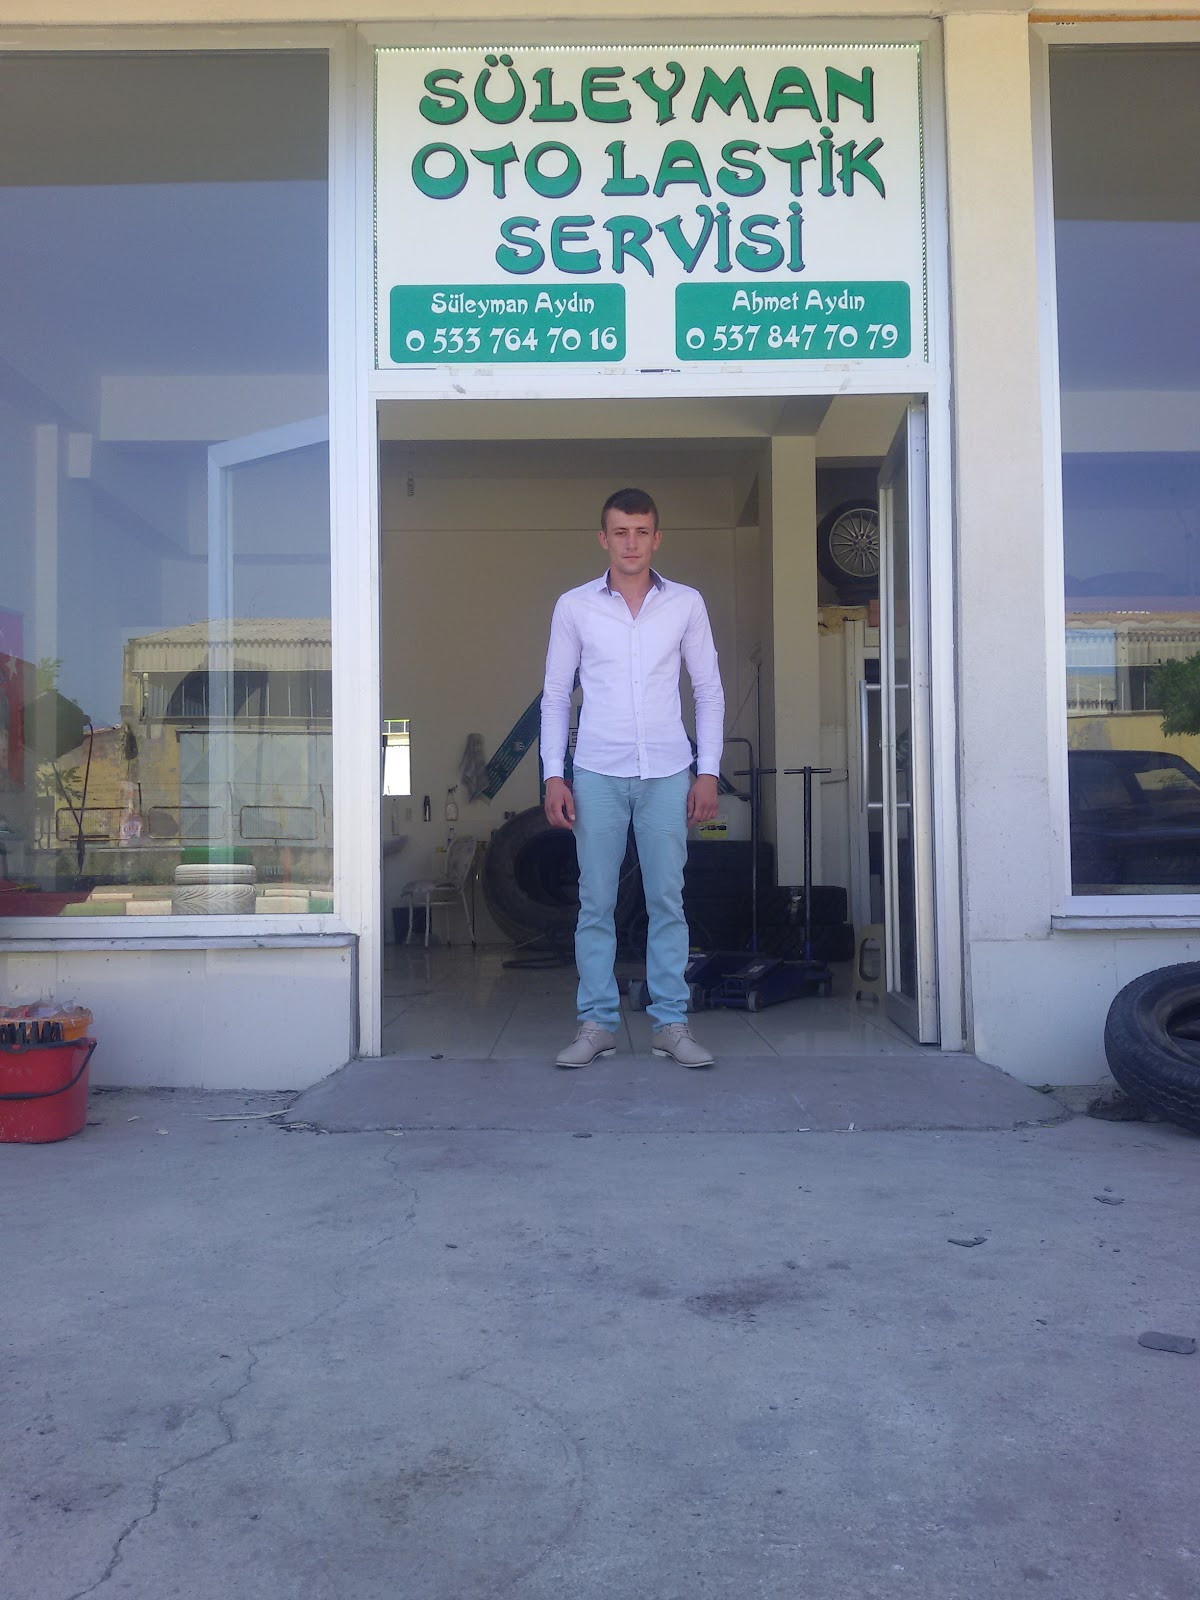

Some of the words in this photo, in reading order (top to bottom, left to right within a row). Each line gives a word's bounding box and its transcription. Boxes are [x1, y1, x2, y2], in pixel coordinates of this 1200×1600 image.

[419, 54, 875, 126] SÜLEYMAN
[411, 140, 582, 200] OTO
[600, 126, 886, 200] LASTİK
[495, 201, 806, 278] SERVİSİ
[431, 292, 528, 318] Süleyman
[534, 291, 595, 318] Aydın
[732, 289, 799, 315] Ahmet
[804, 289, 865, 315] Aydın
[432, 327, 481, 354] 533
[489, 327, 539, 354] 764
[546, 327, 581, 354] 70
[589, 326, 618, 351] 16
[712, 324, 761, 352] 537
[767, 324, 817, 352] 847
[823, 324, 858, 352] 70
[866, 323, 898, 351] 79
